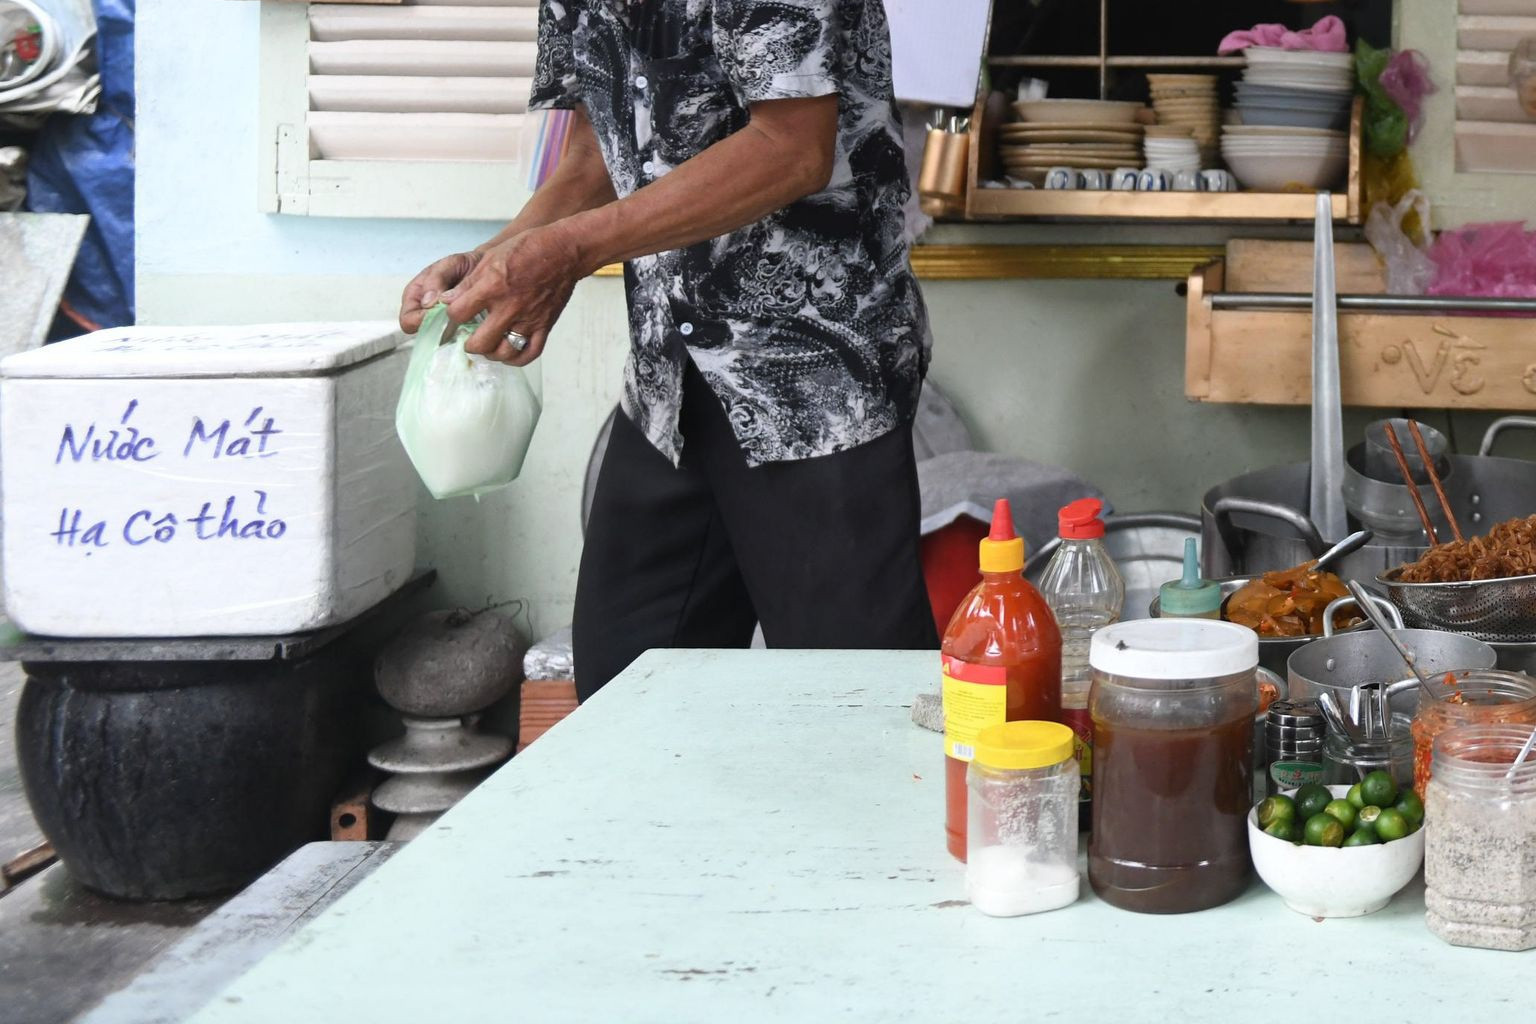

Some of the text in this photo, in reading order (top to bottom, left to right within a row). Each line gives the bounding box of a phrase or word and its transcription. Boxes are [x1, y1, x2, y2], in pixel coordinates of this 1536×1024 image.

[56, 399, 283, 464] Nước Mát
[50, 490, 287, 556] Hạ Cô thảo
